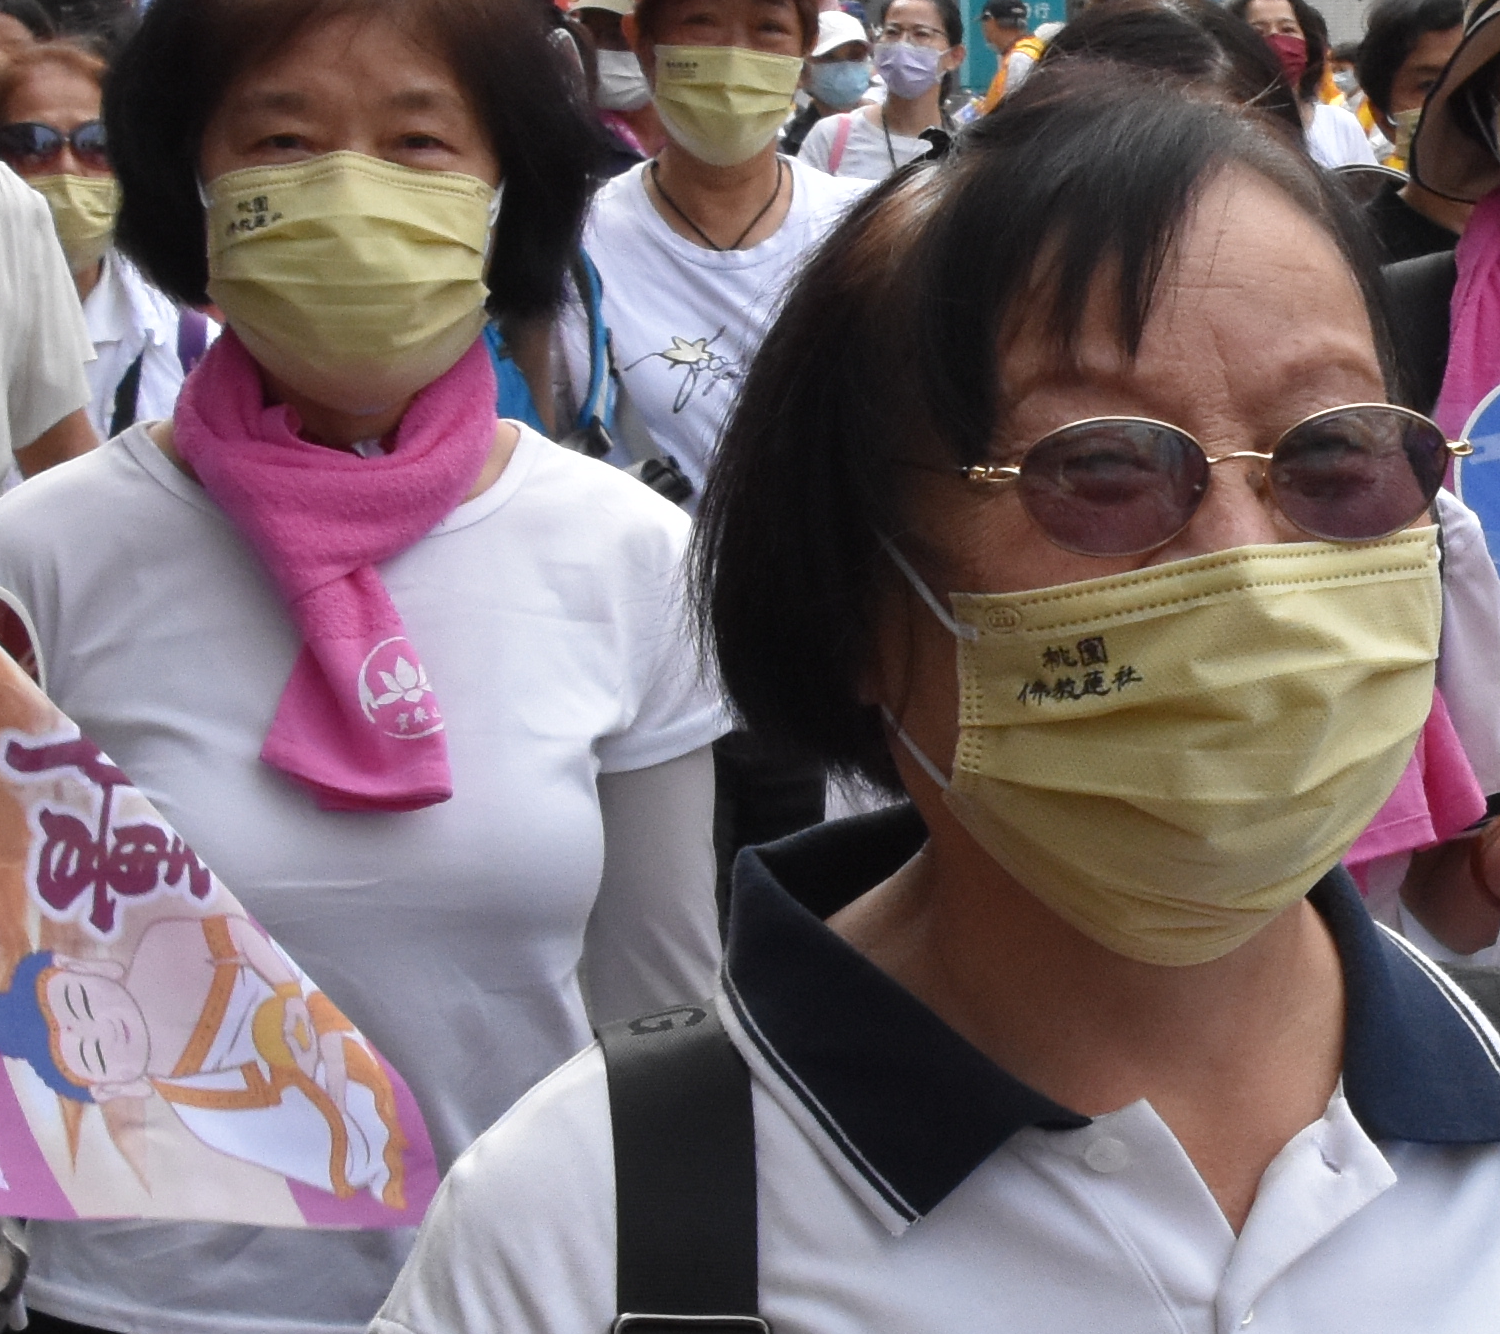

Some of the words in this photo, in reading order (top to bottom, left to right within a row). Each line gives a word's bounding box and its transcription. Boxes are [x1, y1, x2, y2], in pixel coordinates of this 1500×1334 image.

[1042, 636, 1108, 668] 桃園
[1018, 664, 1143, 707] 佛教蓮社
